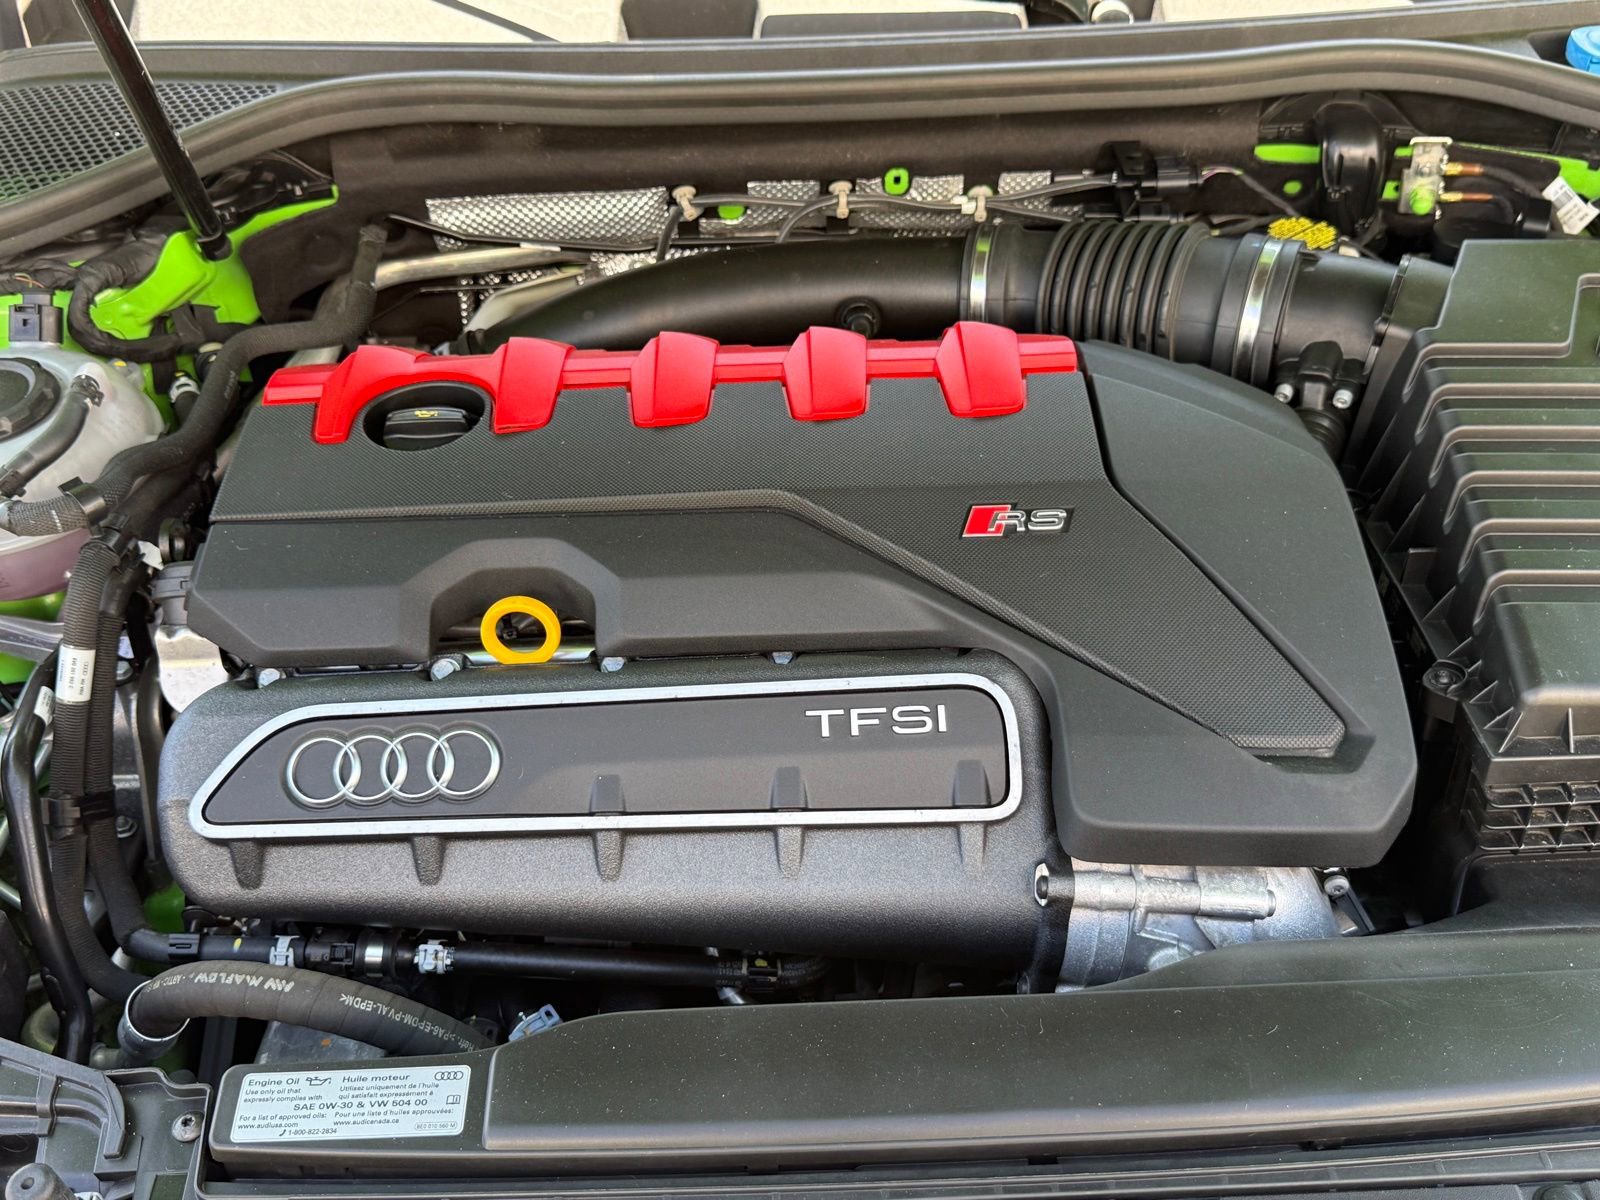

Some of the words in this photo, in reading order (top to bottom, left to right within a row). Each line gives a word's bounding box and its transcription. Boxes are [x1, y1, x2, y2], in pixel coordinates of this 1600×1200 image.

[983, 508, 1067, 533] RS
[805, 704, 947, 737] TFSI
[194, 972, 263, 987] MAFLOW
[248, 1079, 283, 1087] Engine
[342, 1075, 369, 1083] Huile
[371, 1074, 411, 1082] moteur
[366, 1083, 408, 1091] uniquement
[260, 1088, 275, 1096] only
[379, 1091, 428, 1099] expressément
[243, 1096, 275, 1104] expressly
[277, 1095, 307, 1103] complies
[293, 1103, 316, 1111] SAE
[318, 1101, 354, 1110] 0W-30
[356, 1100, 366, 1108] &
[369, 1099, 389, 1107] VW
[391, 1099, 412, 1107] 504
[414, 1098, 428, 1106] 00
[239, 1114, 251, 1122] For
[278, 1112, 311, 1122] approved
[237, 1121, 299, 1130] www.audiusa.com
[333, 1118, 400, 1126] www.audicanada.ca
[288, 1127, 337, 1136] 1-800-822-2834
